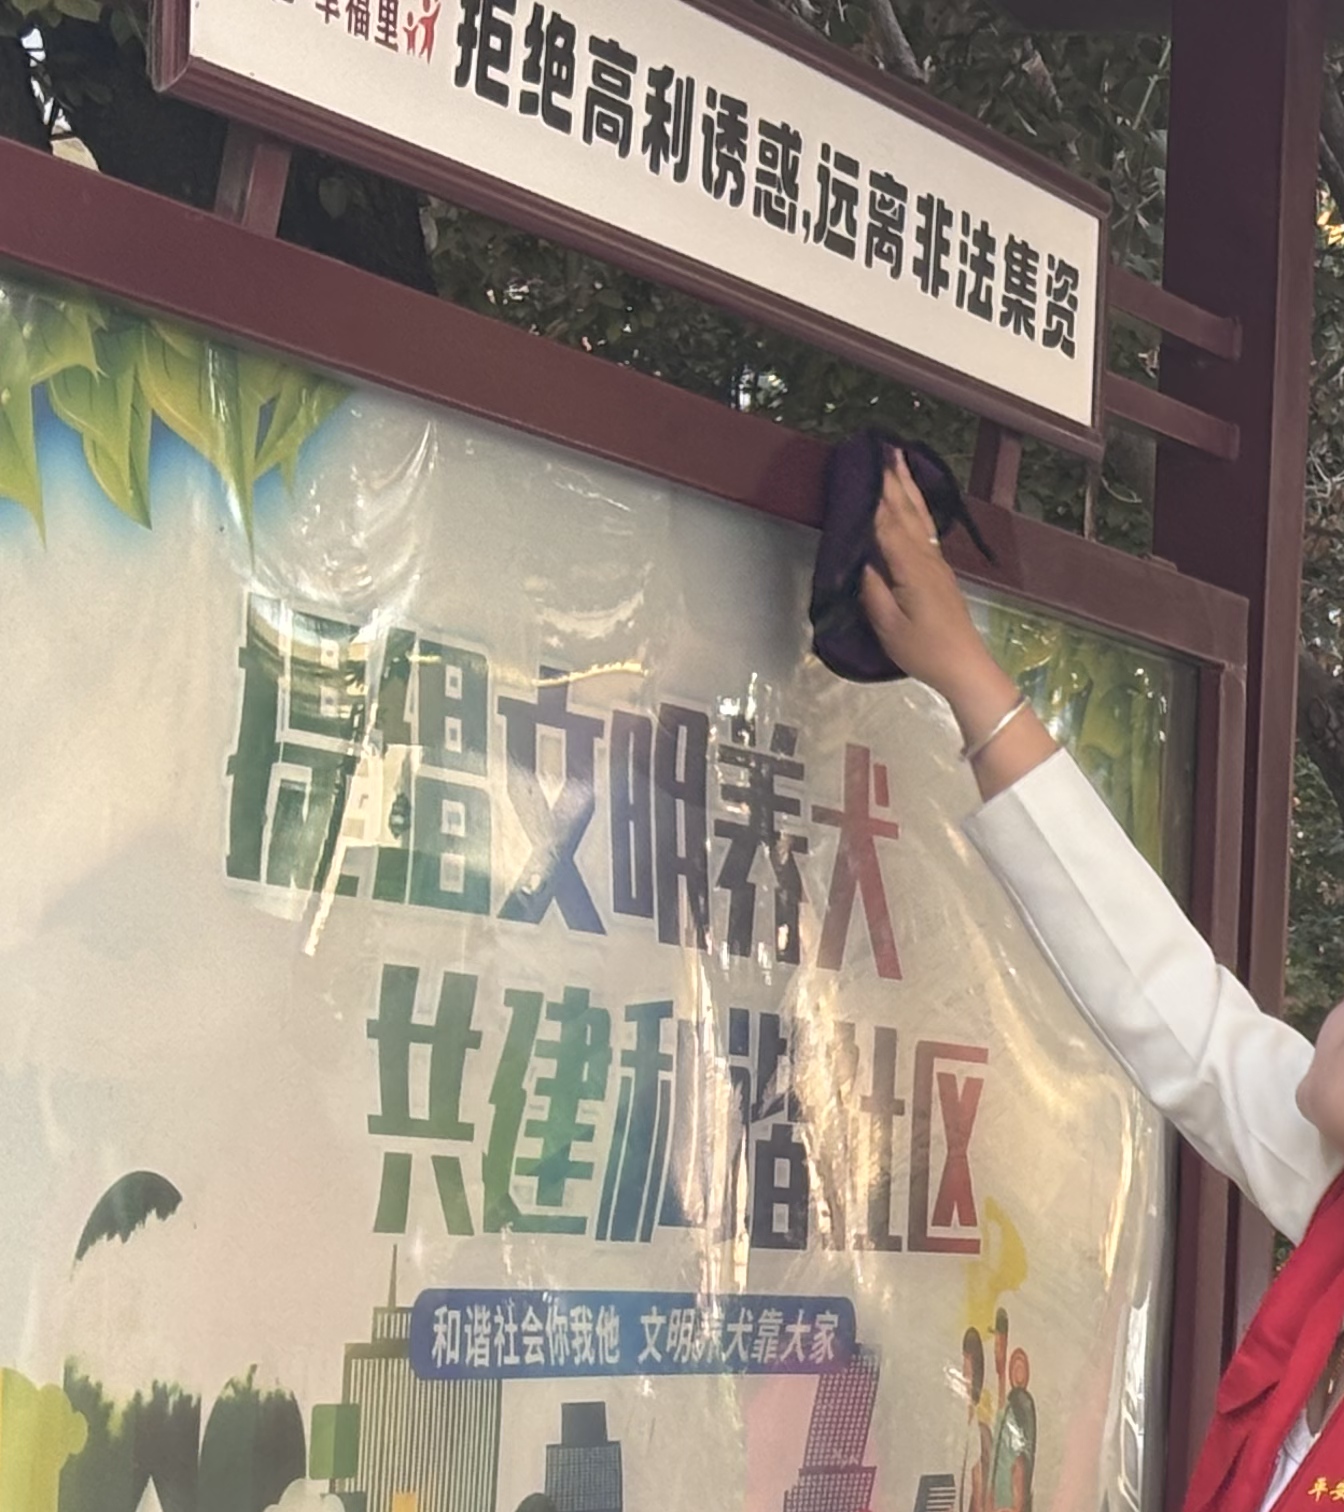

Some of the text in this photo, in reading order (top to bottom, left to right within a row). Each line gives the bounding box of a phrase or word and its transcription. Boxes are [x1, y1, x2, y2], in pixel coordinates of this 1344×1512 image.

[431, 1302, 840, 1368] 和谐社会你我他 文明养犬靠大家
